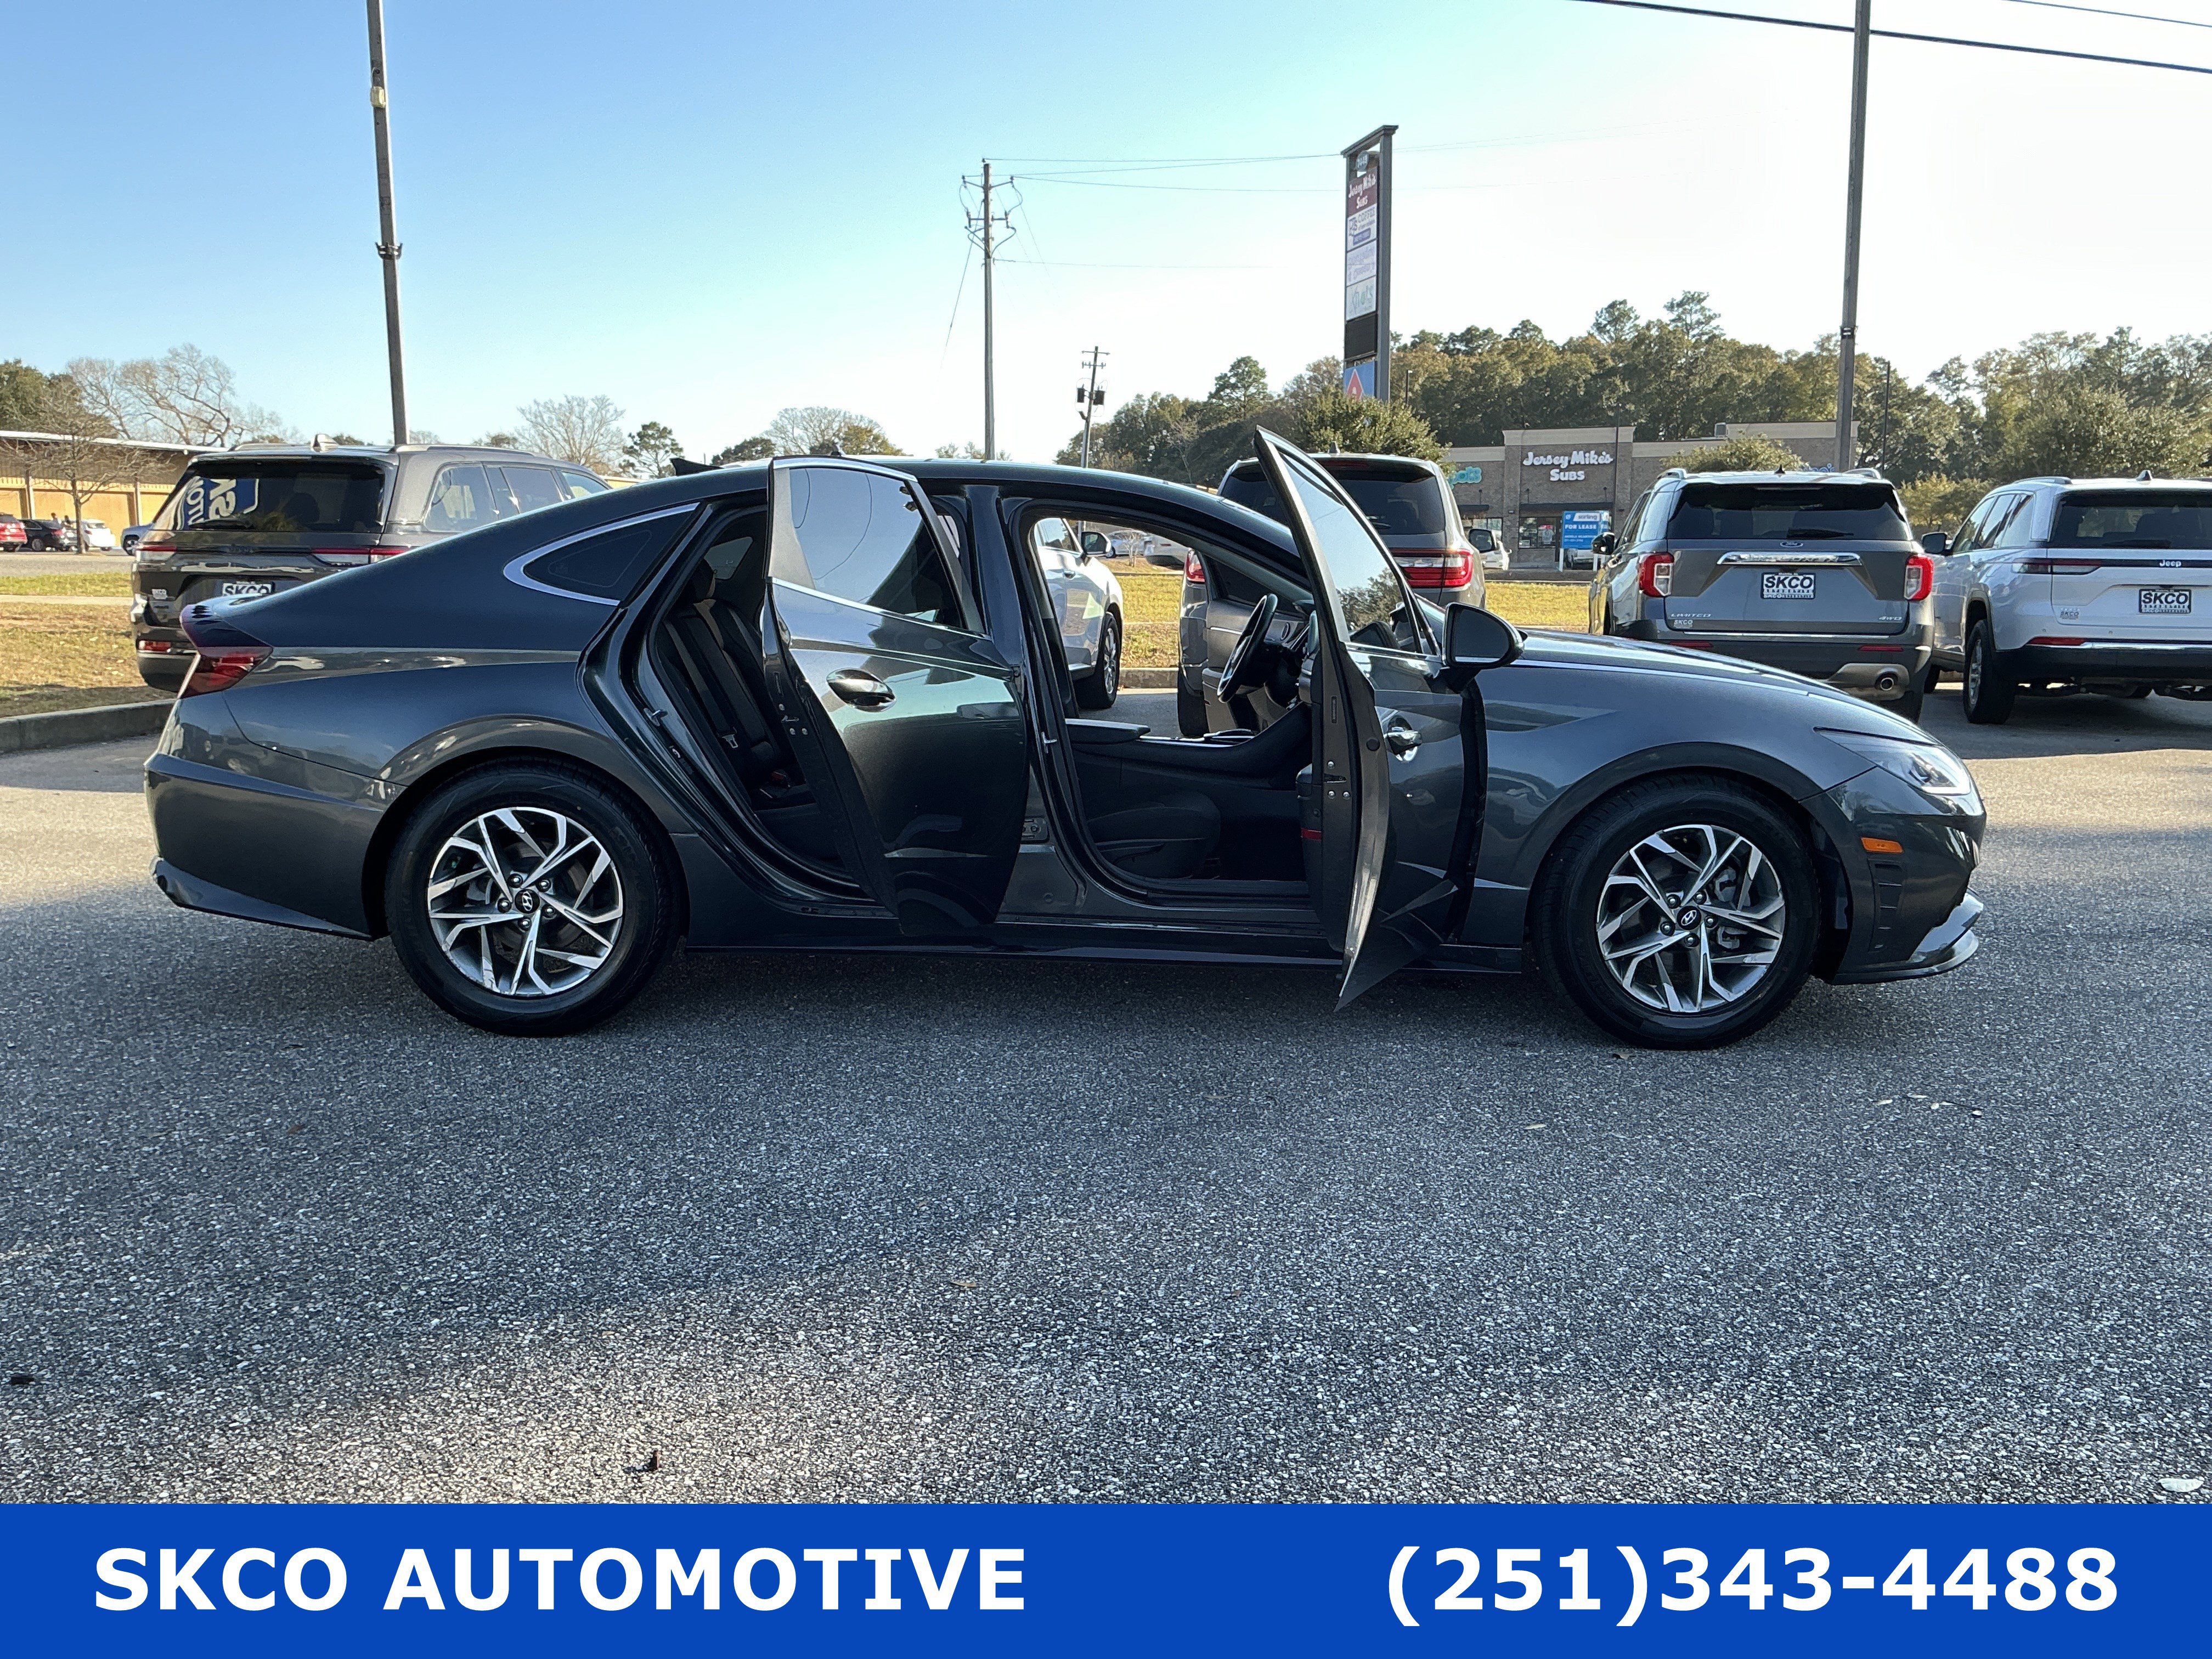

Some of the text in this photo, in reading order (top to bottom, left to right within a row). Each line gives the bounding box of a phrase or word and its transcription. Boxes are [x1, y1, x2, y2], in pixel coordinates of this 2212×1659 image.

[1523, 450, 1613, 469] Jersey Mike's
[1764, 576, 1813, 589] SKCO
[2142, 592, 2188, 605] SKCO
